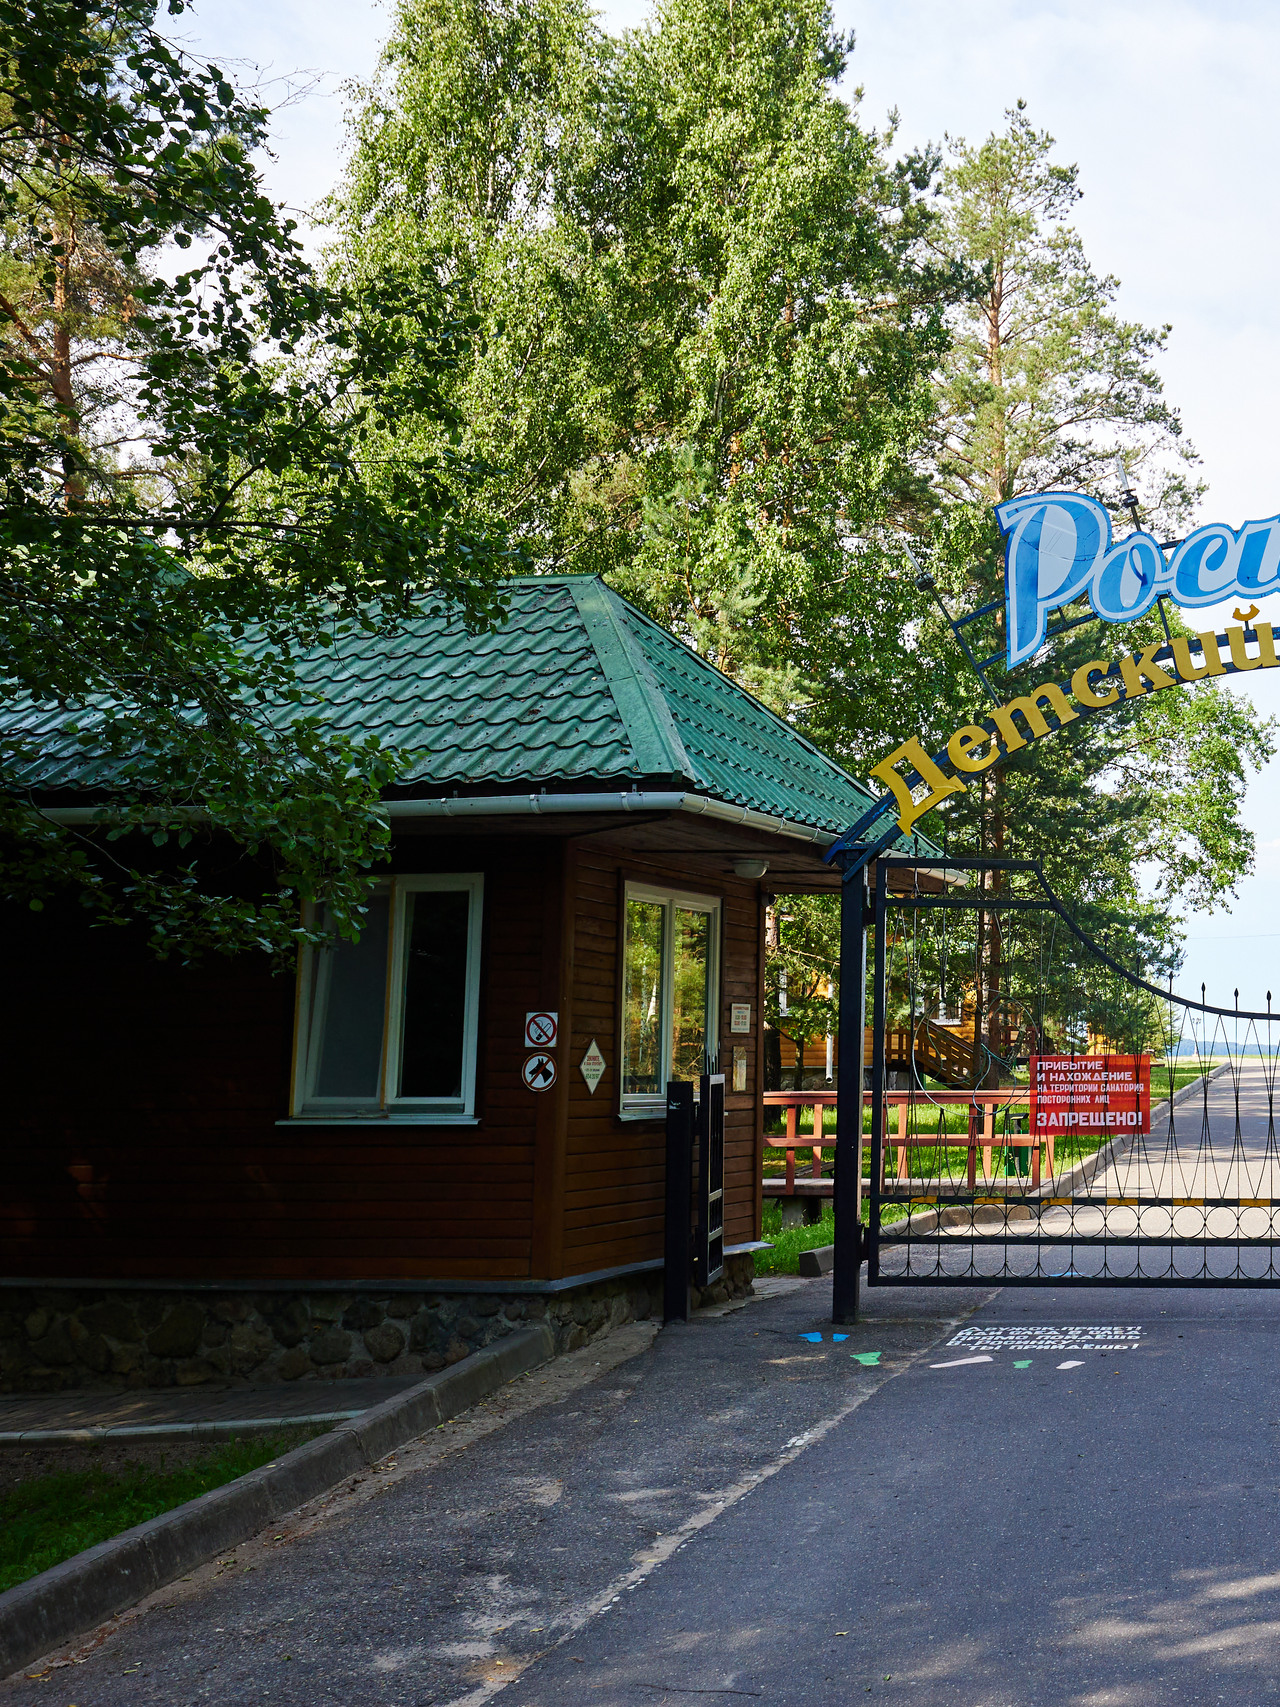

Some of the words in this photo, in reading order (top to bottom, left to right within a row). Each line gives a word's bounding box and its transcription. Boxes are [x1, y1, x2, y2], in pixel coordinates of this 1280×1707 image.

[869, 603, 1280, 837] Детский
[1036, 1061, 1103, 1070] ПРИБЫТИЕ
[1036, 1072, 1045, 1082] И
[1049, 1072, 1133, 1082] НАХОЖДЕНИЕ
[1037, 1084, 1047, 1093] НА
[1049, 1083, 1098, 1092] ТЕРРИТОРИИ
[1100, 1083, 1144, 1092] САНАТОРИЯ
[1037, 1095, 1091, 1104] ПОСТОРОННИХ
[1094, 1095, 1110, 1104] ЛИЦ
[1036, 1111, 1143, 1127] ЗАПРЕЩЕНО!
